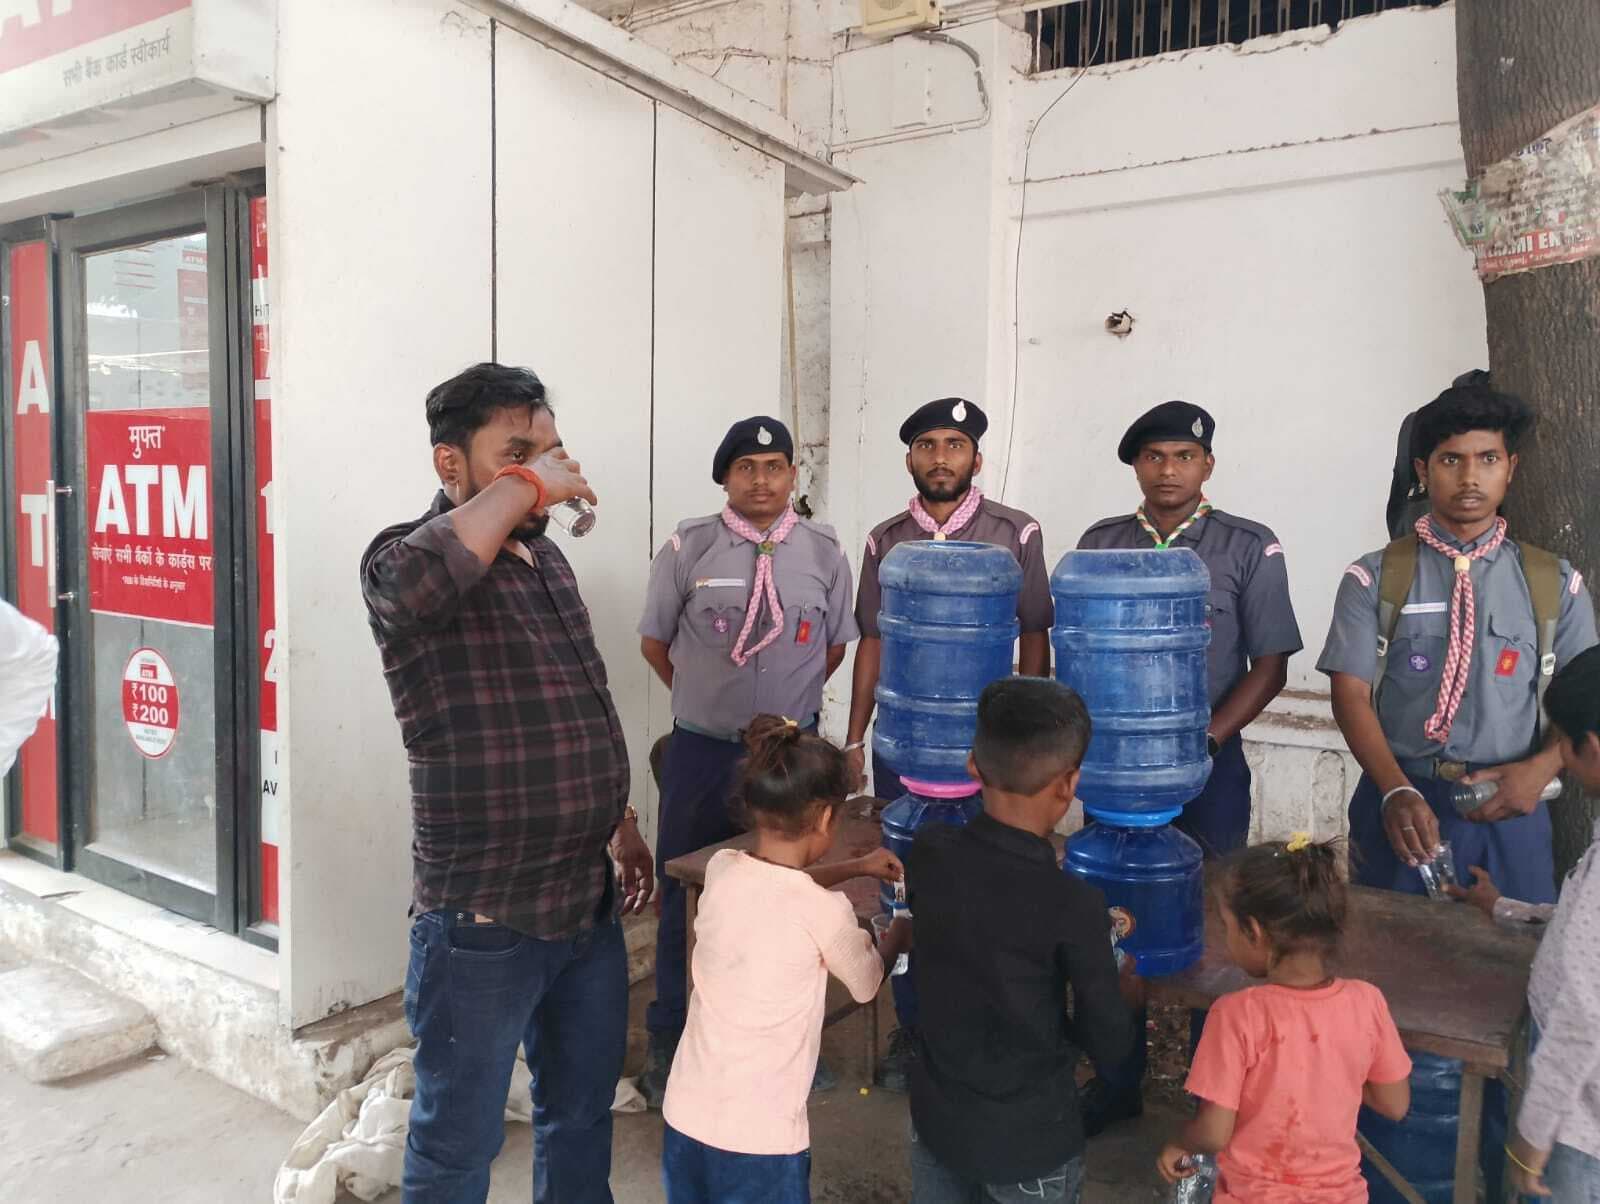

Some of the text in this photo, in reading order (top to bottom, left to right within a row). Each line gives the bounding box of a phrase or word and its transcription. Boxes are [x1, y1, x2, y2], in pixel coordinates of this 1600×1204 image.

[105, 43, 128, 72] कार्ड
[129, 28, 170, 65] स्वीकार्य
[94, 464, 208, 540] ATM
[115, 544, 132, 563] सभी
[155, 547, 165, 567] के
[198, 555, 212, 571] पर
[130, 682, 168, 705] ₹100
[131, 703, 169, 726] ₹200
